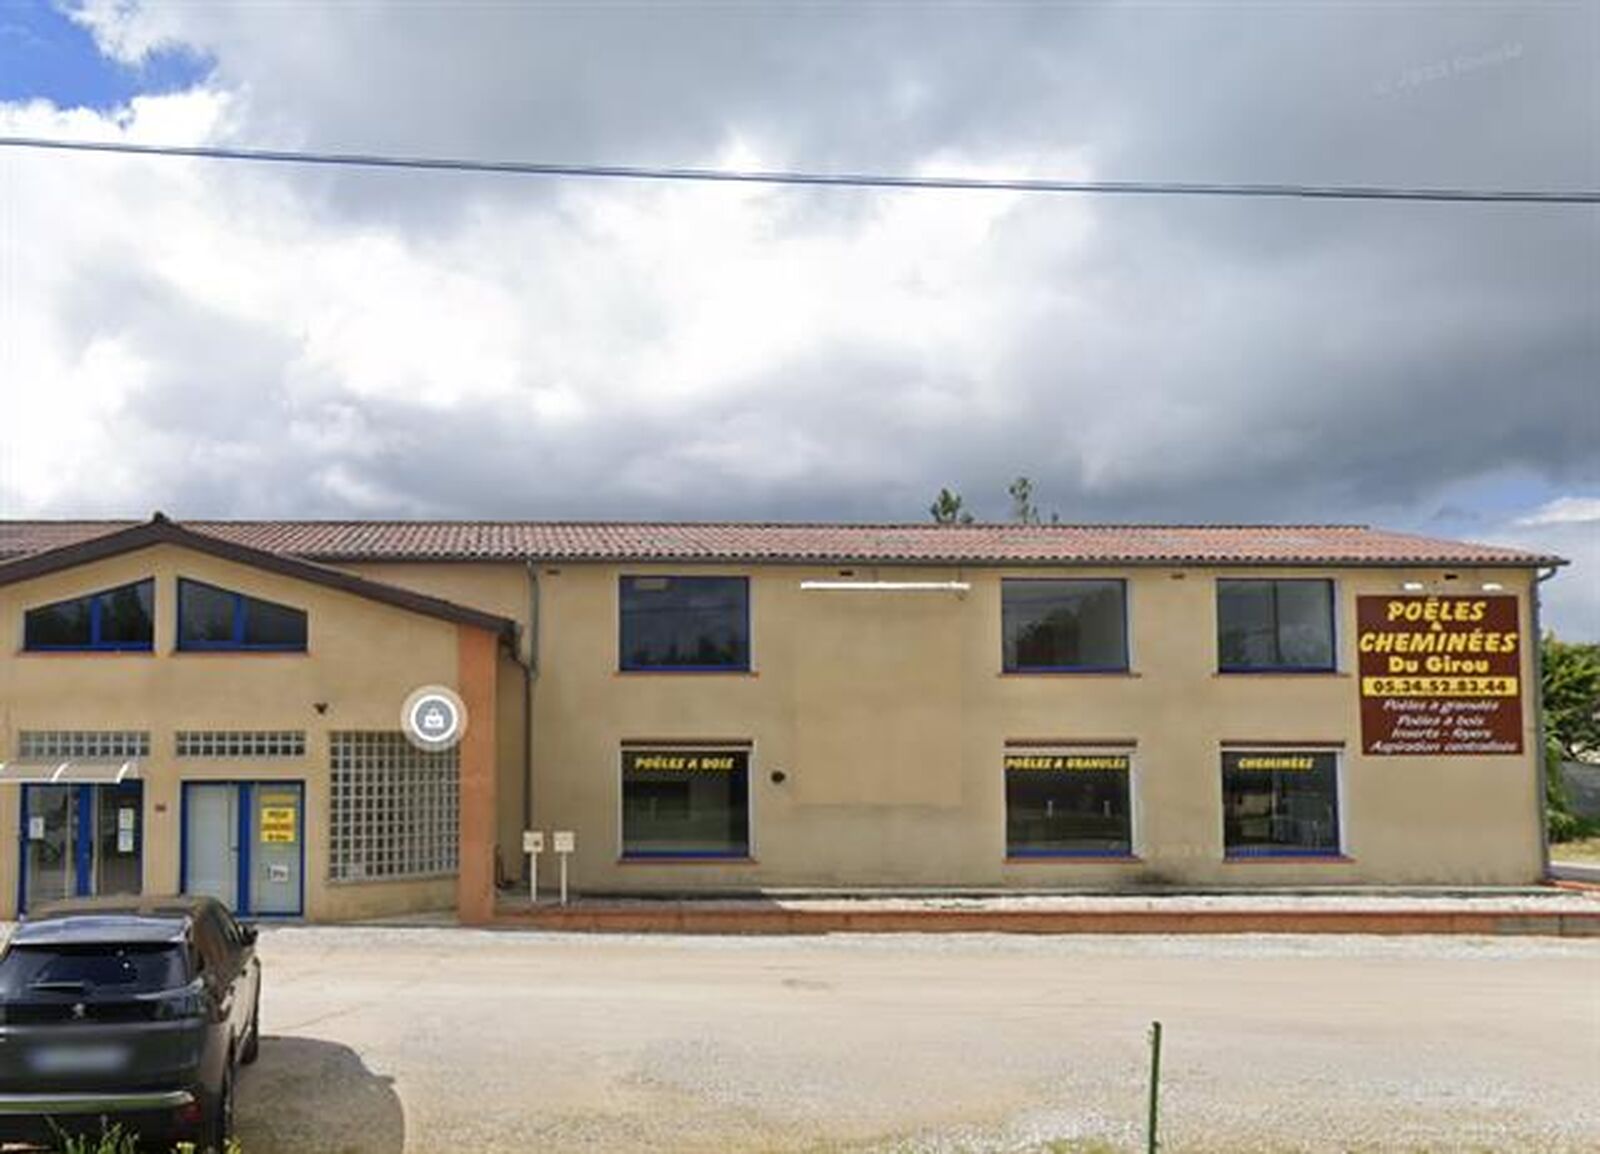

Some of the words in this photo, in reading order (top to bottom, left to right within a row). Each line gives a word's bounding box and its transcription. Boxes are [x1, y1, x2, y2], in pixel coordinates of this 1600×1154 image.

[1360, 629, 1518, 652] CHEMINÉES
[1389, 656, 1418, 673] Du
[1426, 655, 1489, 673] Girou
[1456, 715, 1484, 726] bois
[701, 758, 734, 769] BOIS
